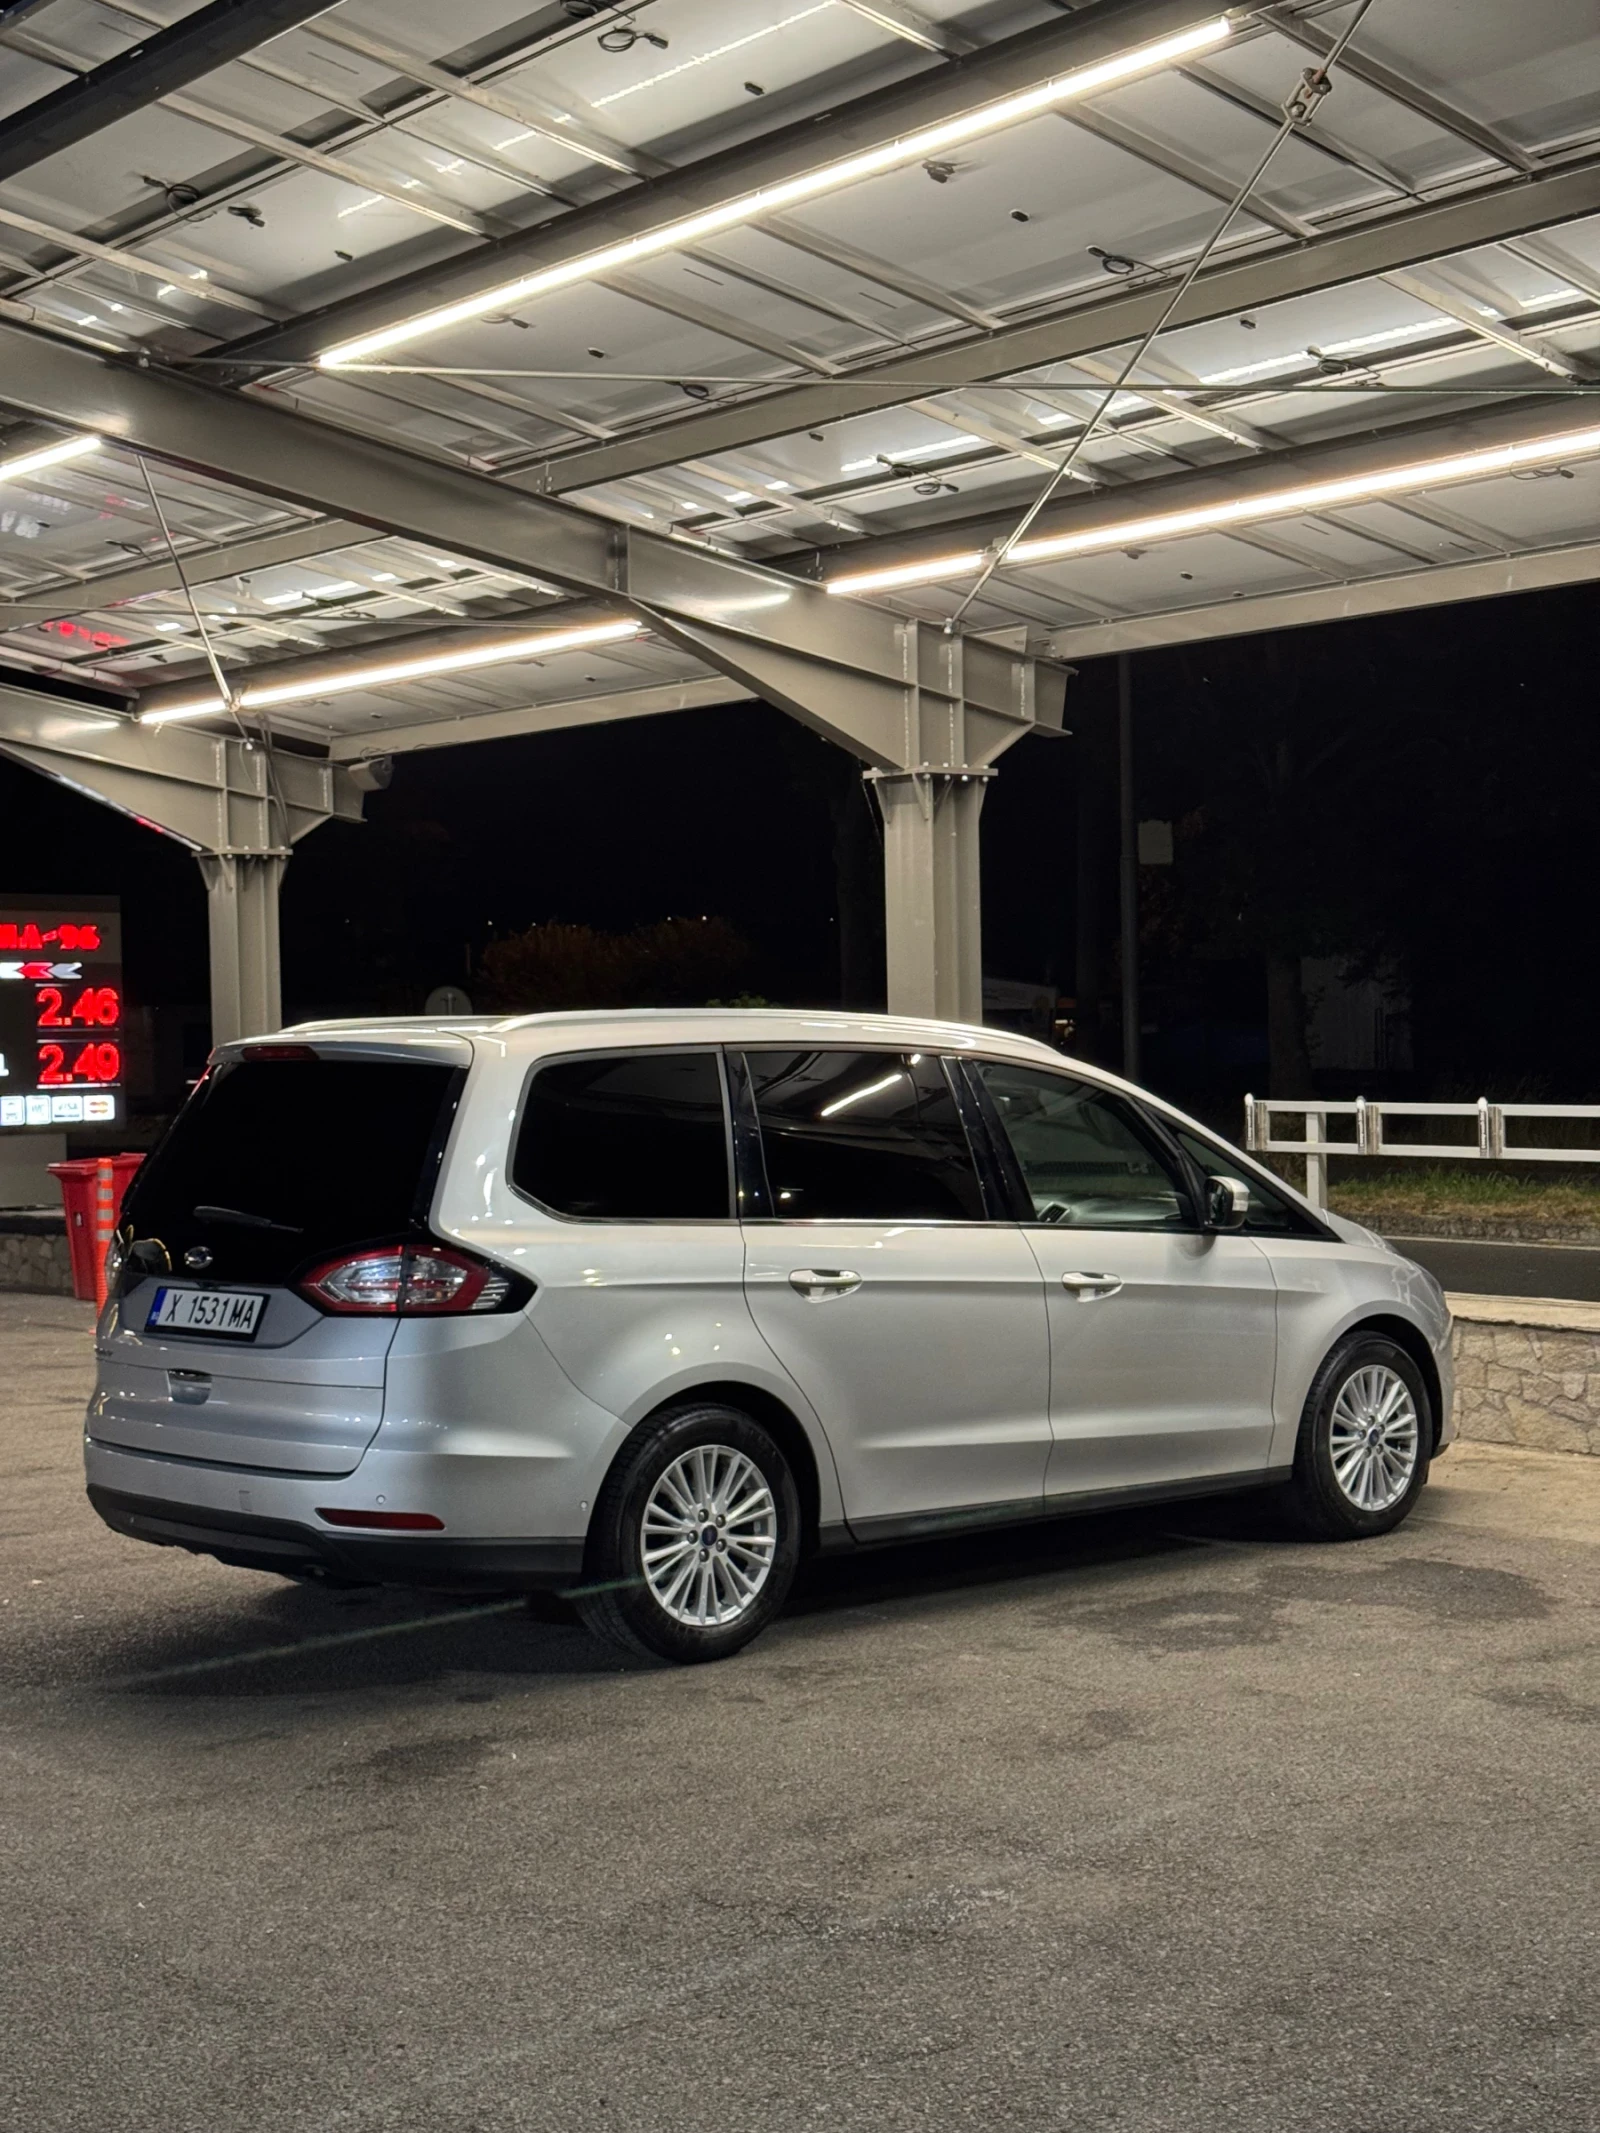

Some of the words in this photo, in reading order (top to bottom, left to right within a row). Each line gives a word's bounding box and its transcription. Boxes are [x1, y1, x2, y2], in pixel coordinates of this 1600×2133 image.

[37, 987, 119, 1026] 2.46
[38, 1043, 119, 1082] 2.49
[165, 1293, 183, 1322] X
